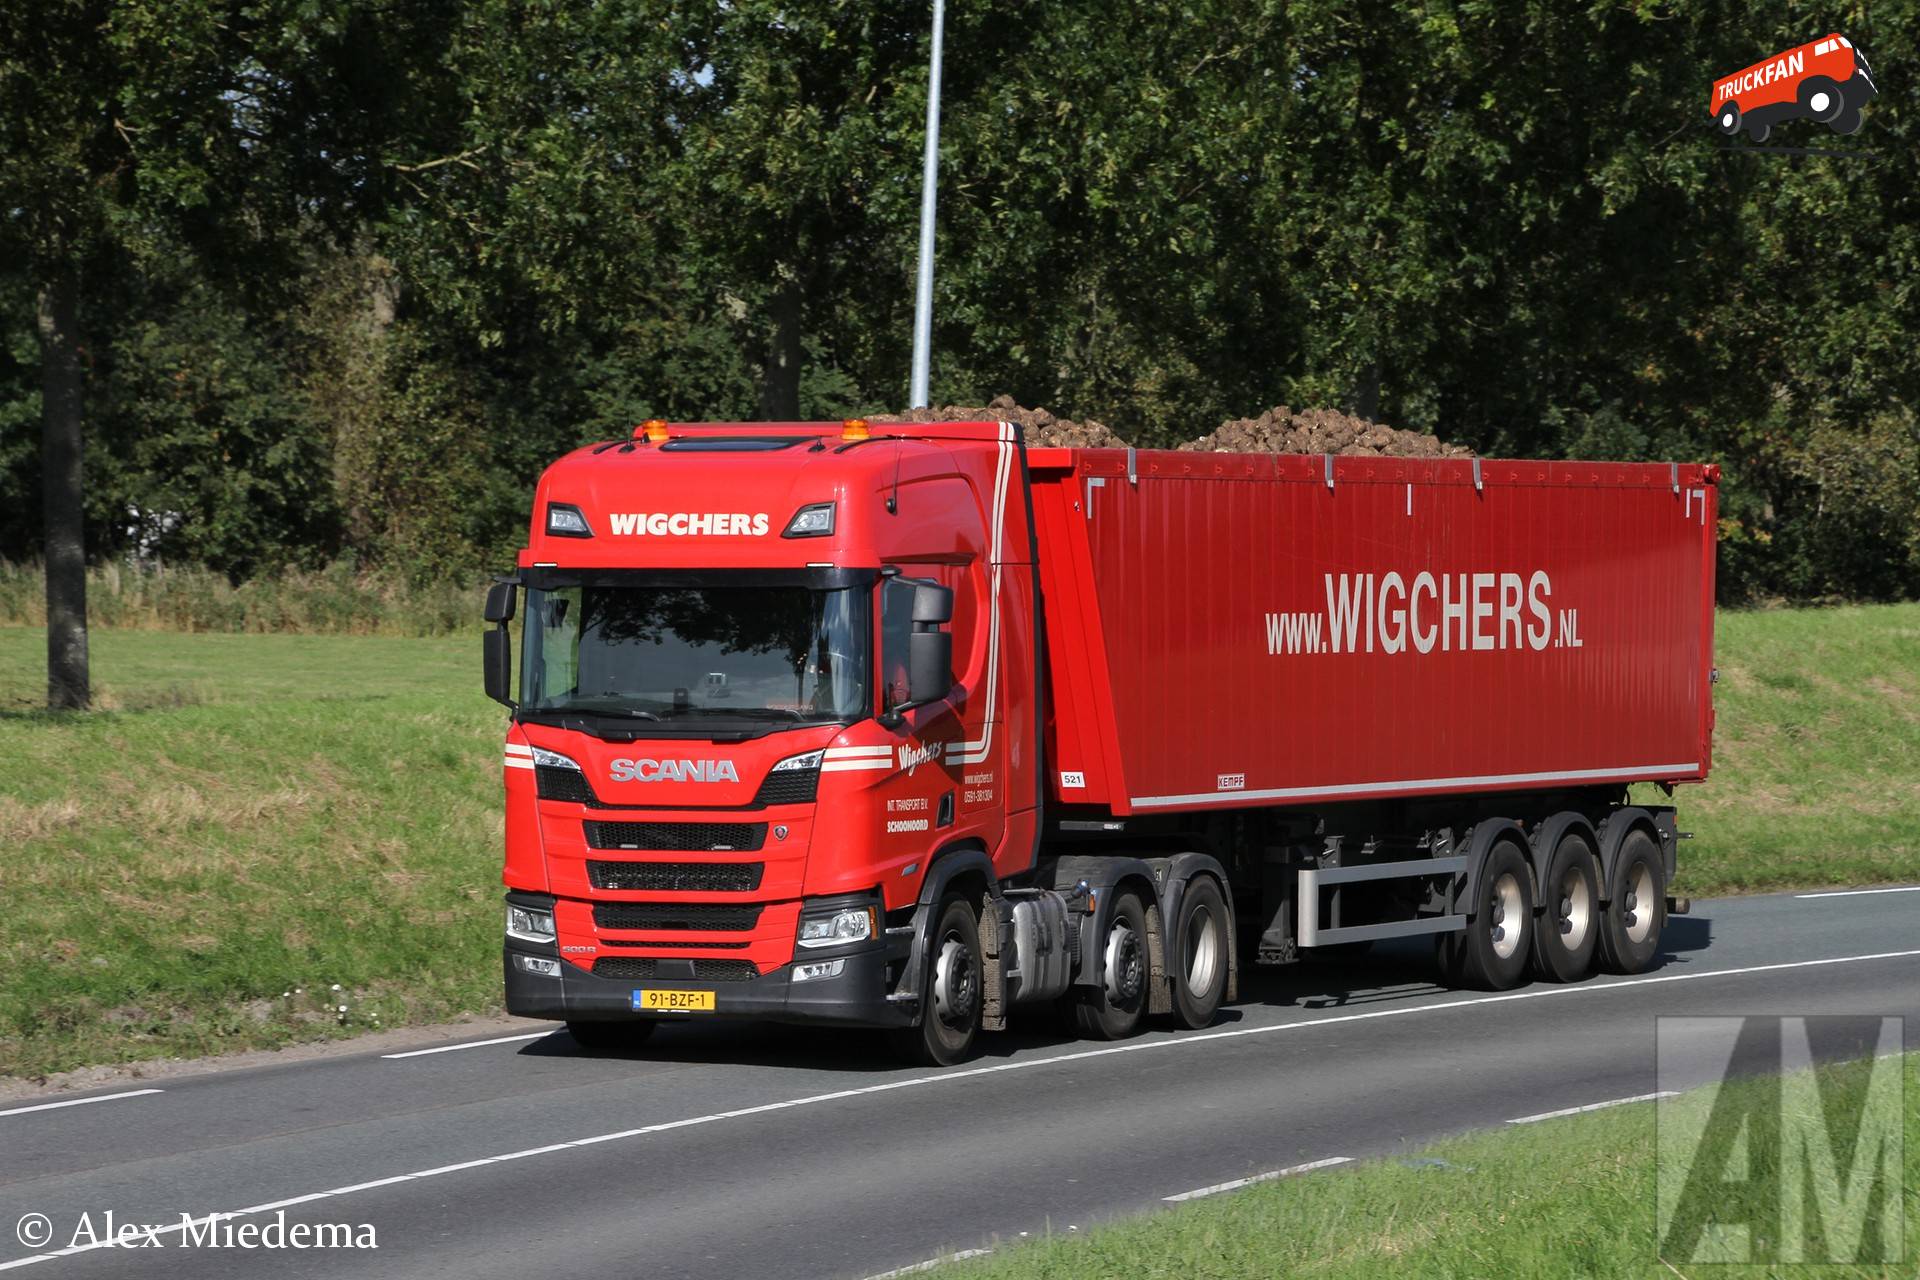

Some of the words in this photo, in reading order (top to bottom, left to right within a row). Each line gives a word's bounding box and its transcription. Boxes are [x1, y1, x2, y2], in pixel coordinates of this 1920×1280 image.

[609, 513, 769, 536] WIGCHERS
[898, 740, 943, 777] Wigchers
[609, 758, 740, 782] SCANIA
[1064, 775, 1082, 784] 521
[1218, 776, 1244, 788] KEMPF
[896, 799, 920, 811] TRANSPORT
[887, 819, 929, 833] SCHOONOORD
[562, 945, 586, 953] 500
[649, 992, 705, 1007] 91-BZF-1
